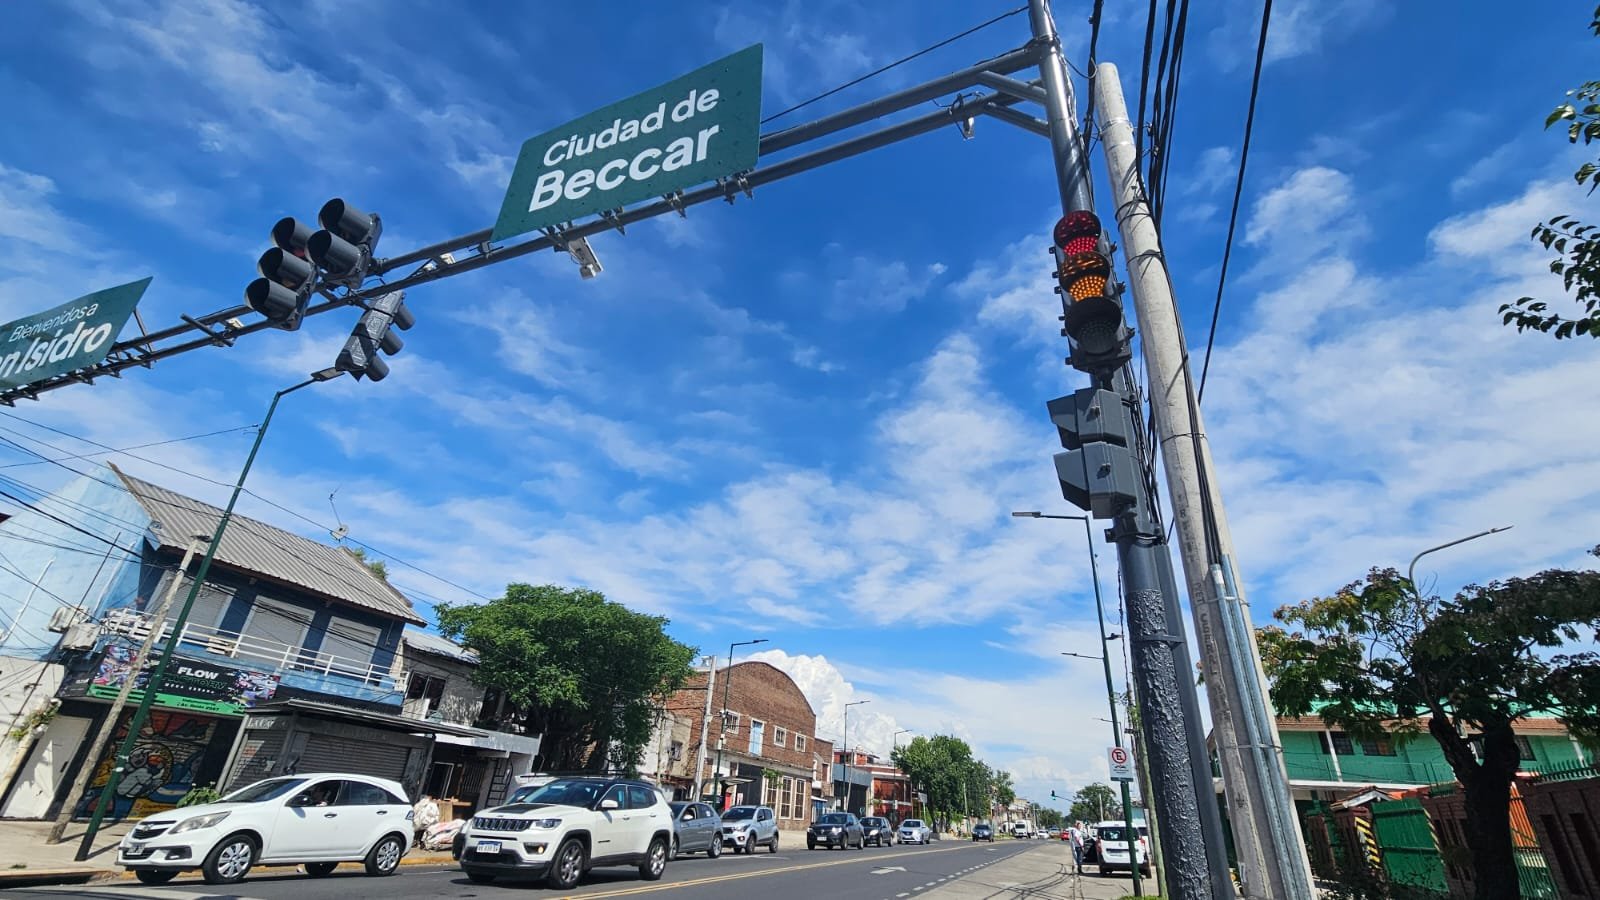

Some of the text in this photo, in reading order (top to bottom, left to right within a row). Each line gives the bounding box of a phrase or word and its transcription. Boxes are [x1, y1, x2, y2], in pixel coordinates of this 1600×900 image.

[543, 88, 720, 167] Ciudad de
[528, 124, 720, 213] Beccar
[8, 303, 99, 343] Bienvenidos a
[15, 321, 113, 374] Isidro
[177, 666, 219, 680] FLOW
